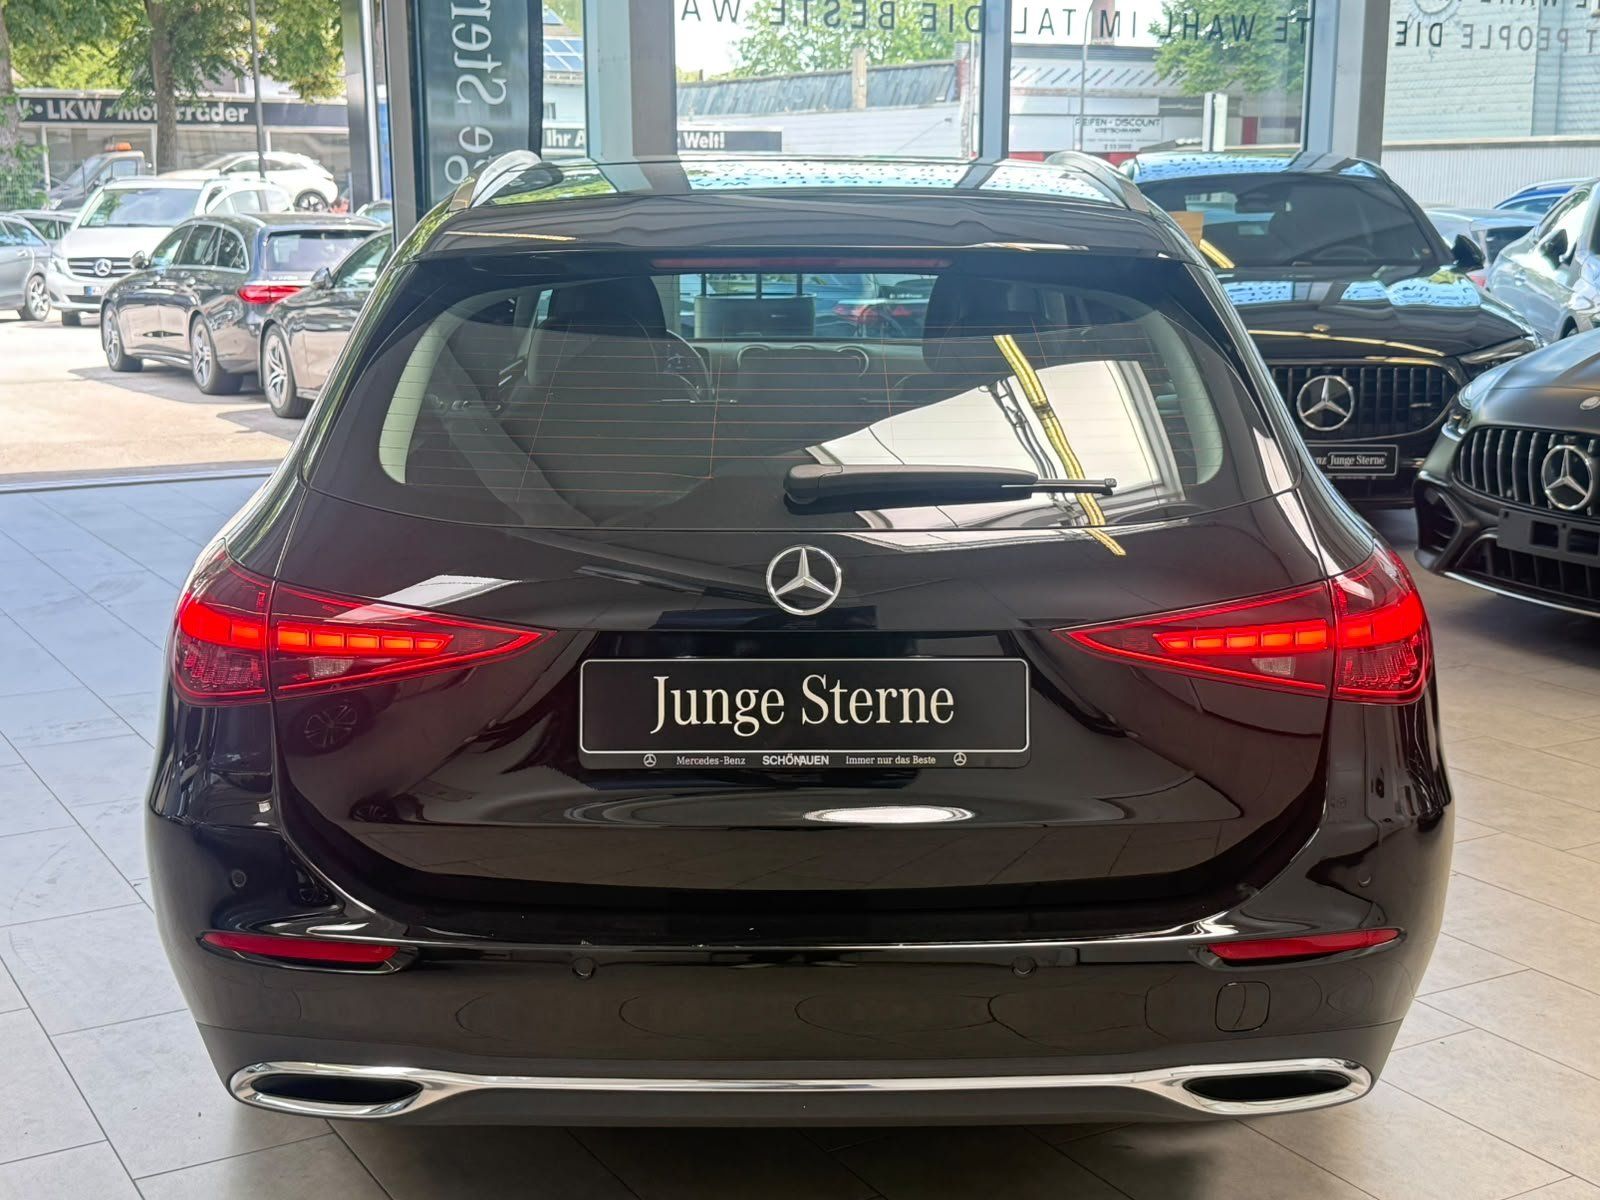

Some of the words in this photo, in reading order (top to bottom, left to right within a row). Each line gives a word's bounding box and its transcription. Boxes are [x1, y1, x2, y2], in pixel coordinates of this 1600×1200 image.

[47, 99, 102, 120] LKW
[118, 101, 249, 122] Motrräder
[546, 129, 571, 147] Ihr
[683, 131, 726, 149] Welt!
[1330, 455, 1355, 466] Junge
[1356, 455, 1385, 465] Sterne
[650, 675, 785, 737] Junge
[802, 674, 955, 725] Sterne
[676, 756, 746, 766] Mercedes-Benz
[762, 753, 830, 766] SCHÖNAUEN
[846, 755, 874, 765] Immer
[877, 757, 894, 765] nur
[895, 755, 911, 765] das
[912, 755, 936, 765] Beste
